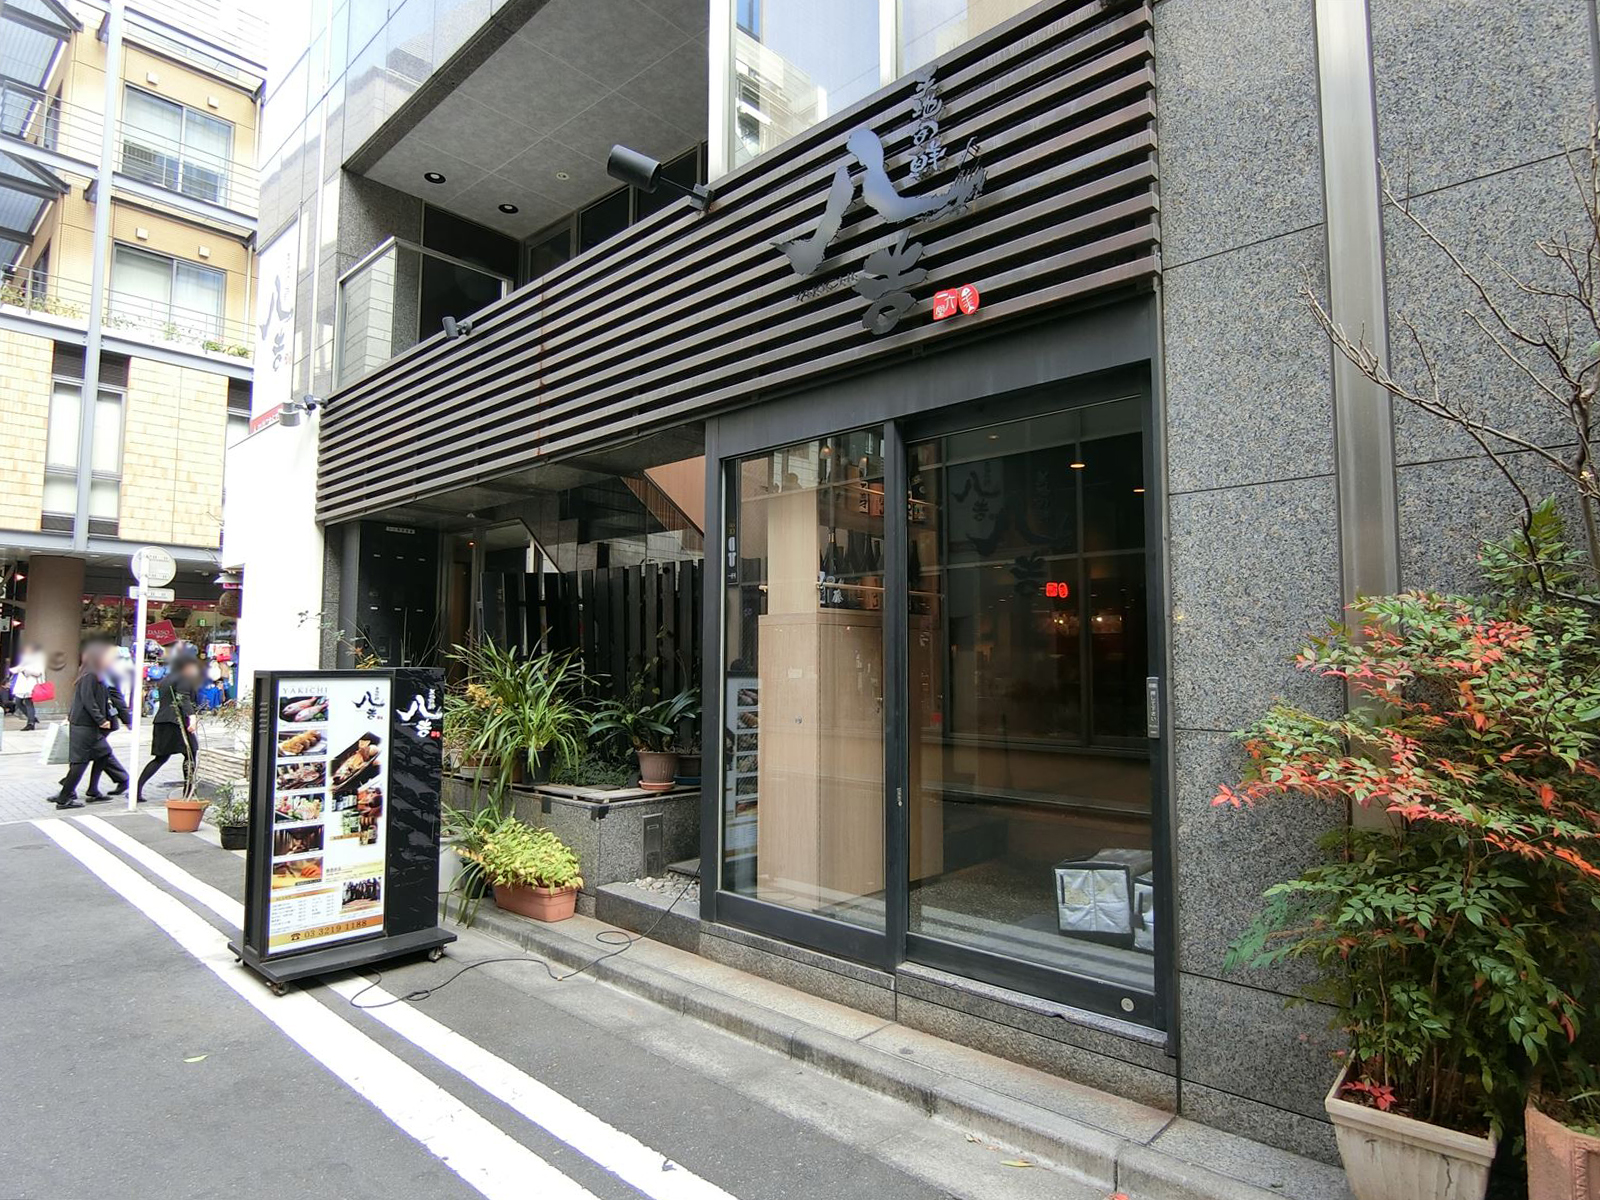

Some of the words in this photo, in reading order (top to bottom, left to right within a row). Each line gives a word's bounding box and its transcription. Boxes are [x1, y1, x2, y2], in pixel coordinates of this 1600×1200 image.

[282, 686, 328, 695] YAKICHI
[303, 930, 316, 938] 03
[318, 924, 342, 936] 3219
[345, 920, 367, 931] 1188
